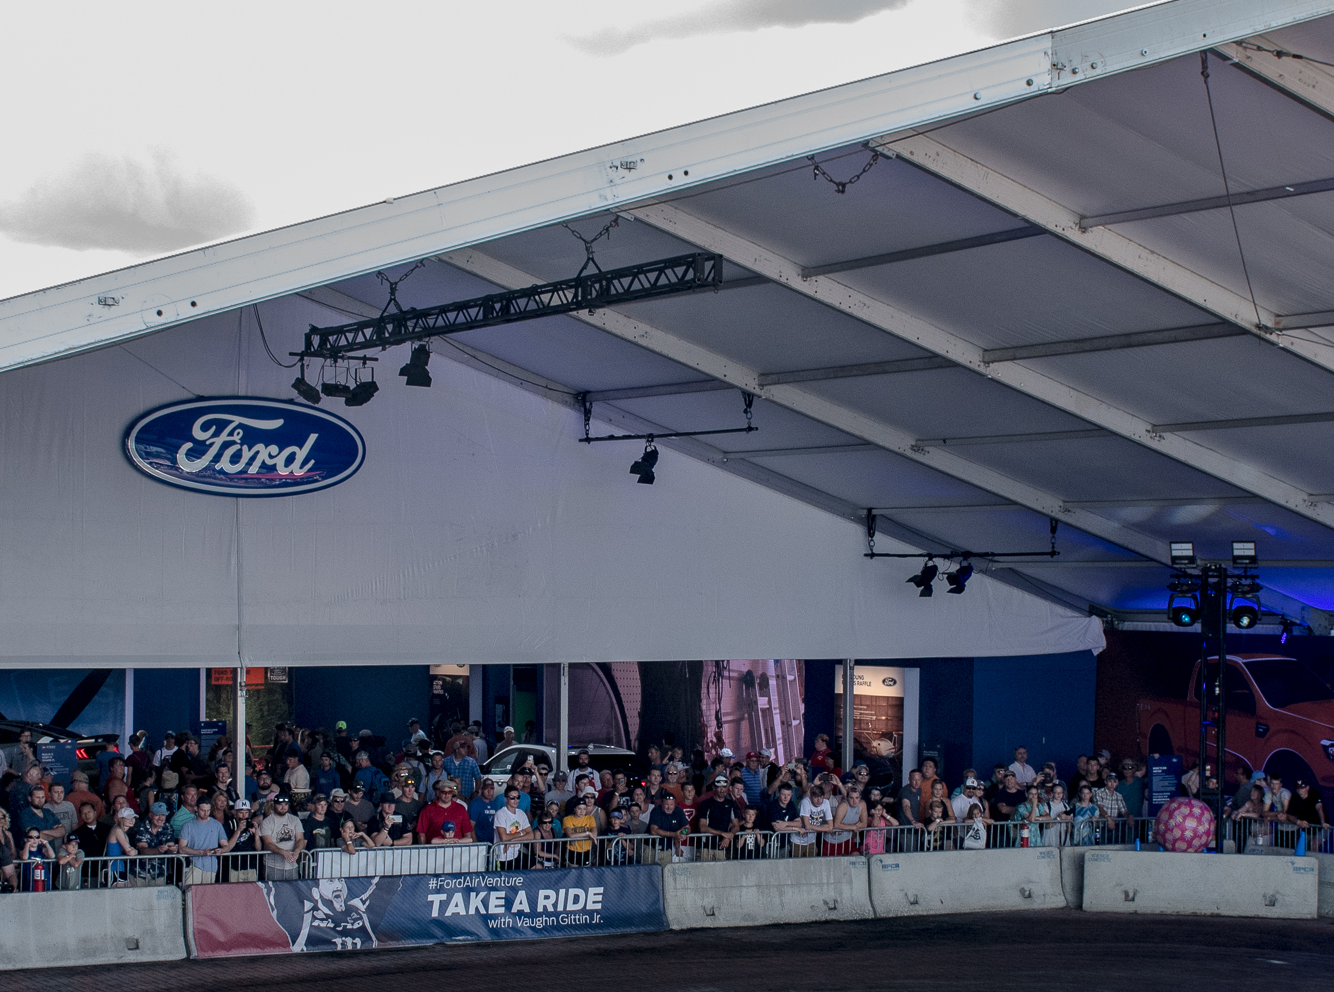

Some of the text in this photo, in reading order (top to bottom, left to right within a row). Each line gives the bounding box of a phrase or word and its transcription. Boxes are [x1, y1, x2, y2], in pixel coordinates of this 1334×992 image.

[177, 413, 318, 475] Ford
[428, 876, 523, 890] #FordAirVenture
[427, 886, 604, 917] TAKE A RIDE
[488, 912, 603, 929] with Vaughn Gittin Jr.
